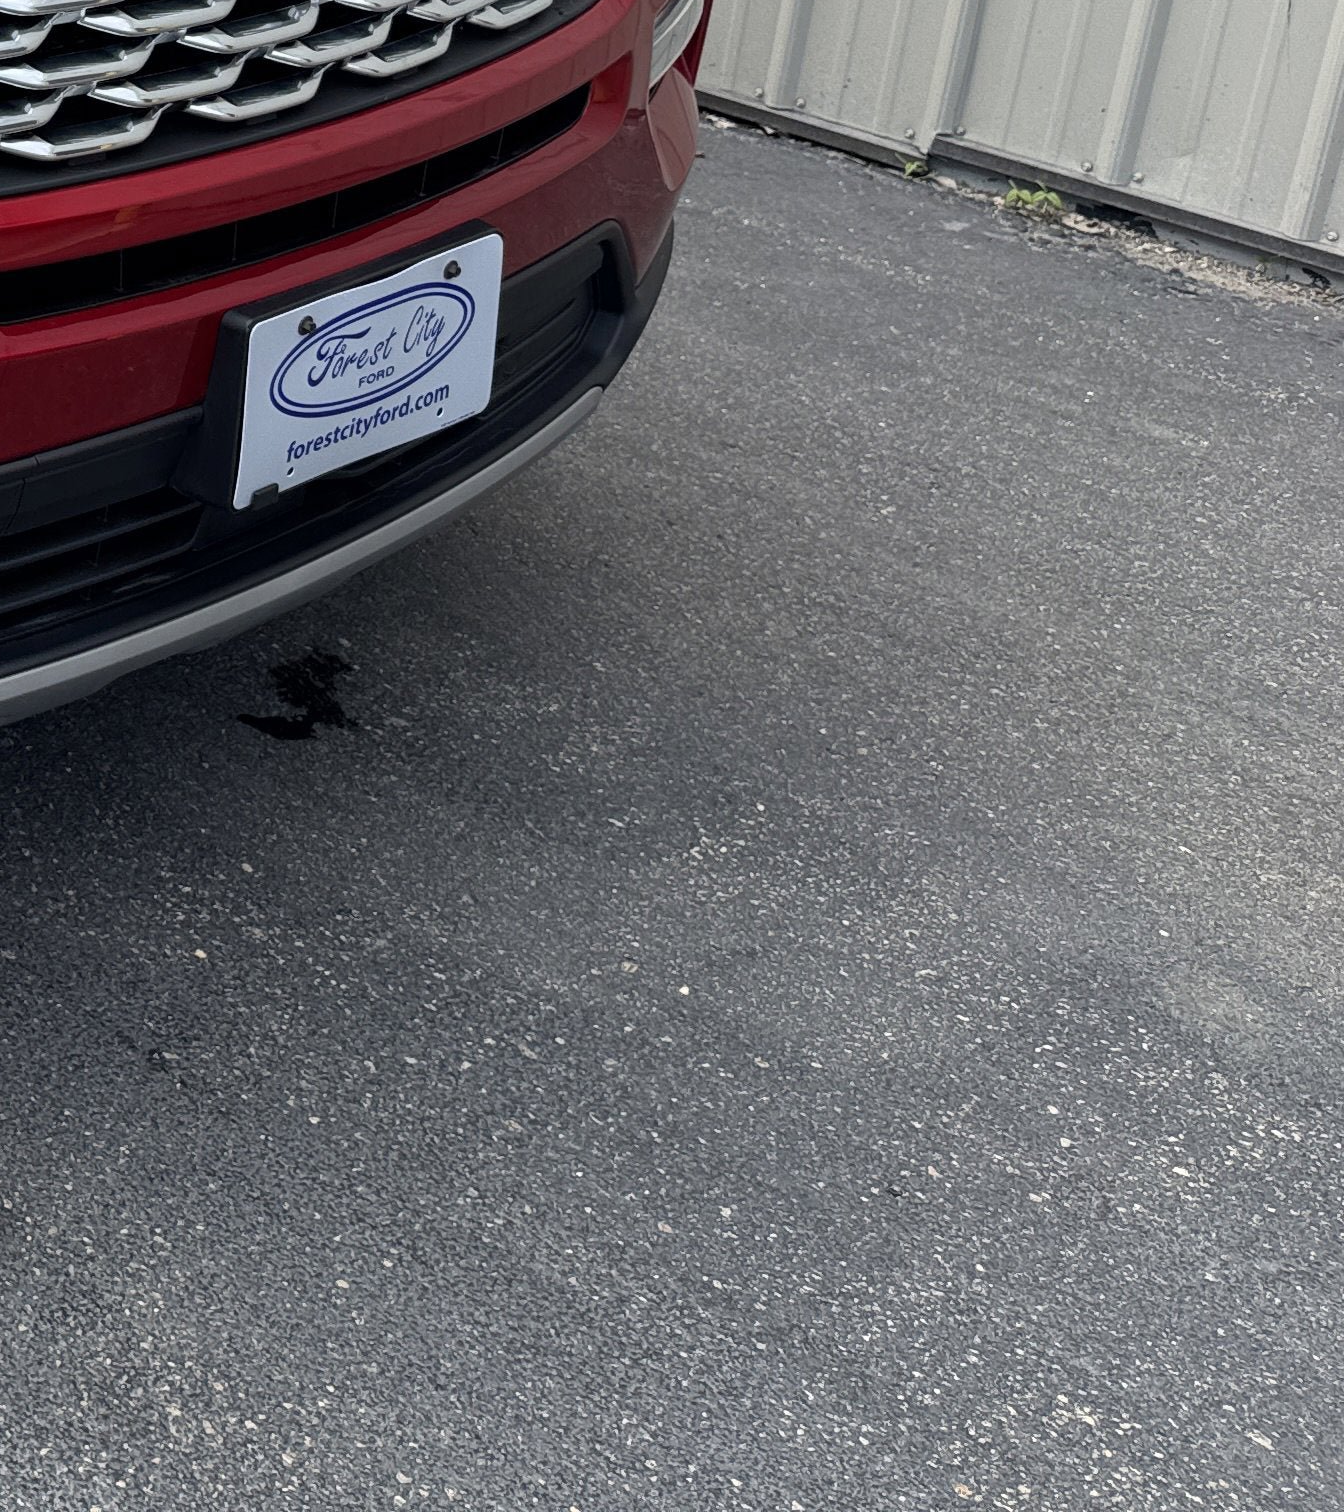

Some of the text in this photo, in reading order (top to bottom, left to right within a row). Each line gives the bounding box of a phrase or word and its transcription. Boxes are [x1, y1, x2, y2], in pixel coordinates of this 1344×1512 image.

[307, 305, 446, 388] Forest City
[358, 365, 395, 389] FORD
[286, 384, 450, 463] forestcityford.com
